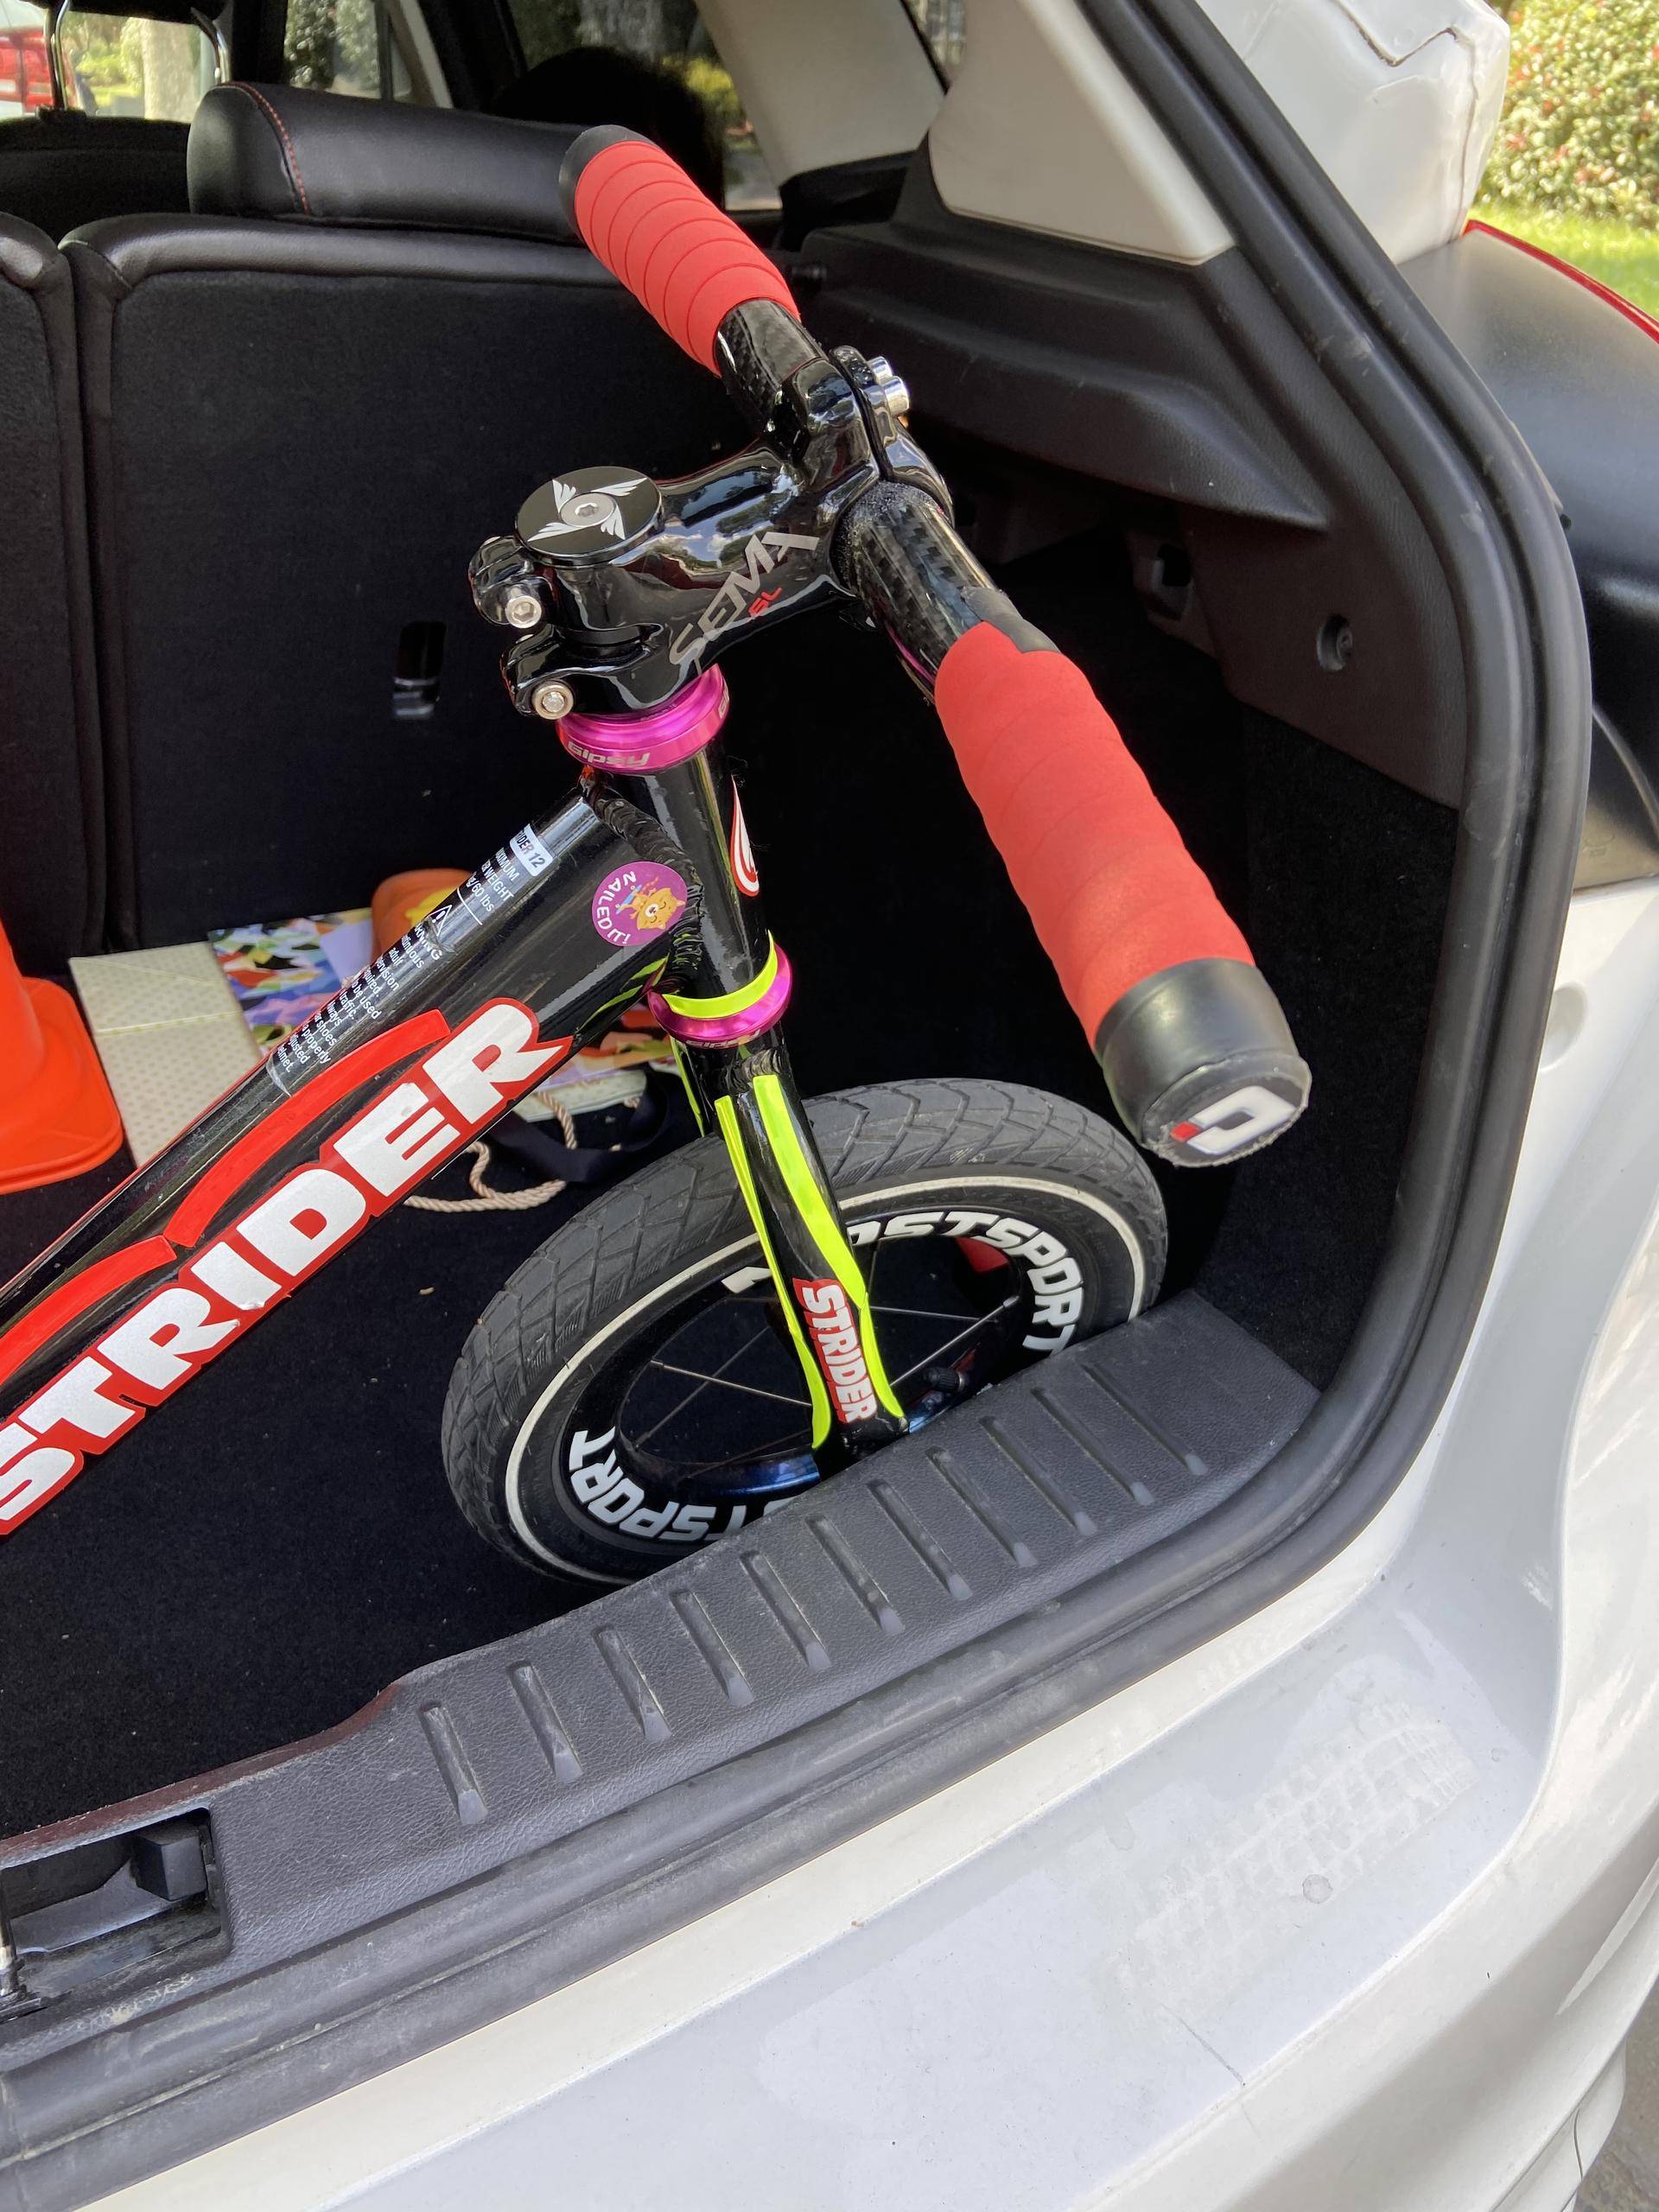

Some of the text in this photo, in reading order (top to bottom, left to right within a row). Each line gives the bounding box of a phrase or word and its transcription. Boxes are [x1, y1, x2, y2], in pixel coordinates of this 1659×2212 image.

[527, 850, 546, 869] 12
[483, 866, 513, 900] WEIGHT
[479, 893, 496, 912] lbs
[597, 871, 637, 930] NAILED
[338, 990, 355, 1020] traffic.
[353, 983, 364, 999] be
[359, 995, 382, 1020] used
[301, 1028, 331, 1063] properly
[316, 1020, 338, 1046] shoes
[0, 1004, 565, 1521] STRIDER
[802, 1284, 878, 1423] STRIDER
